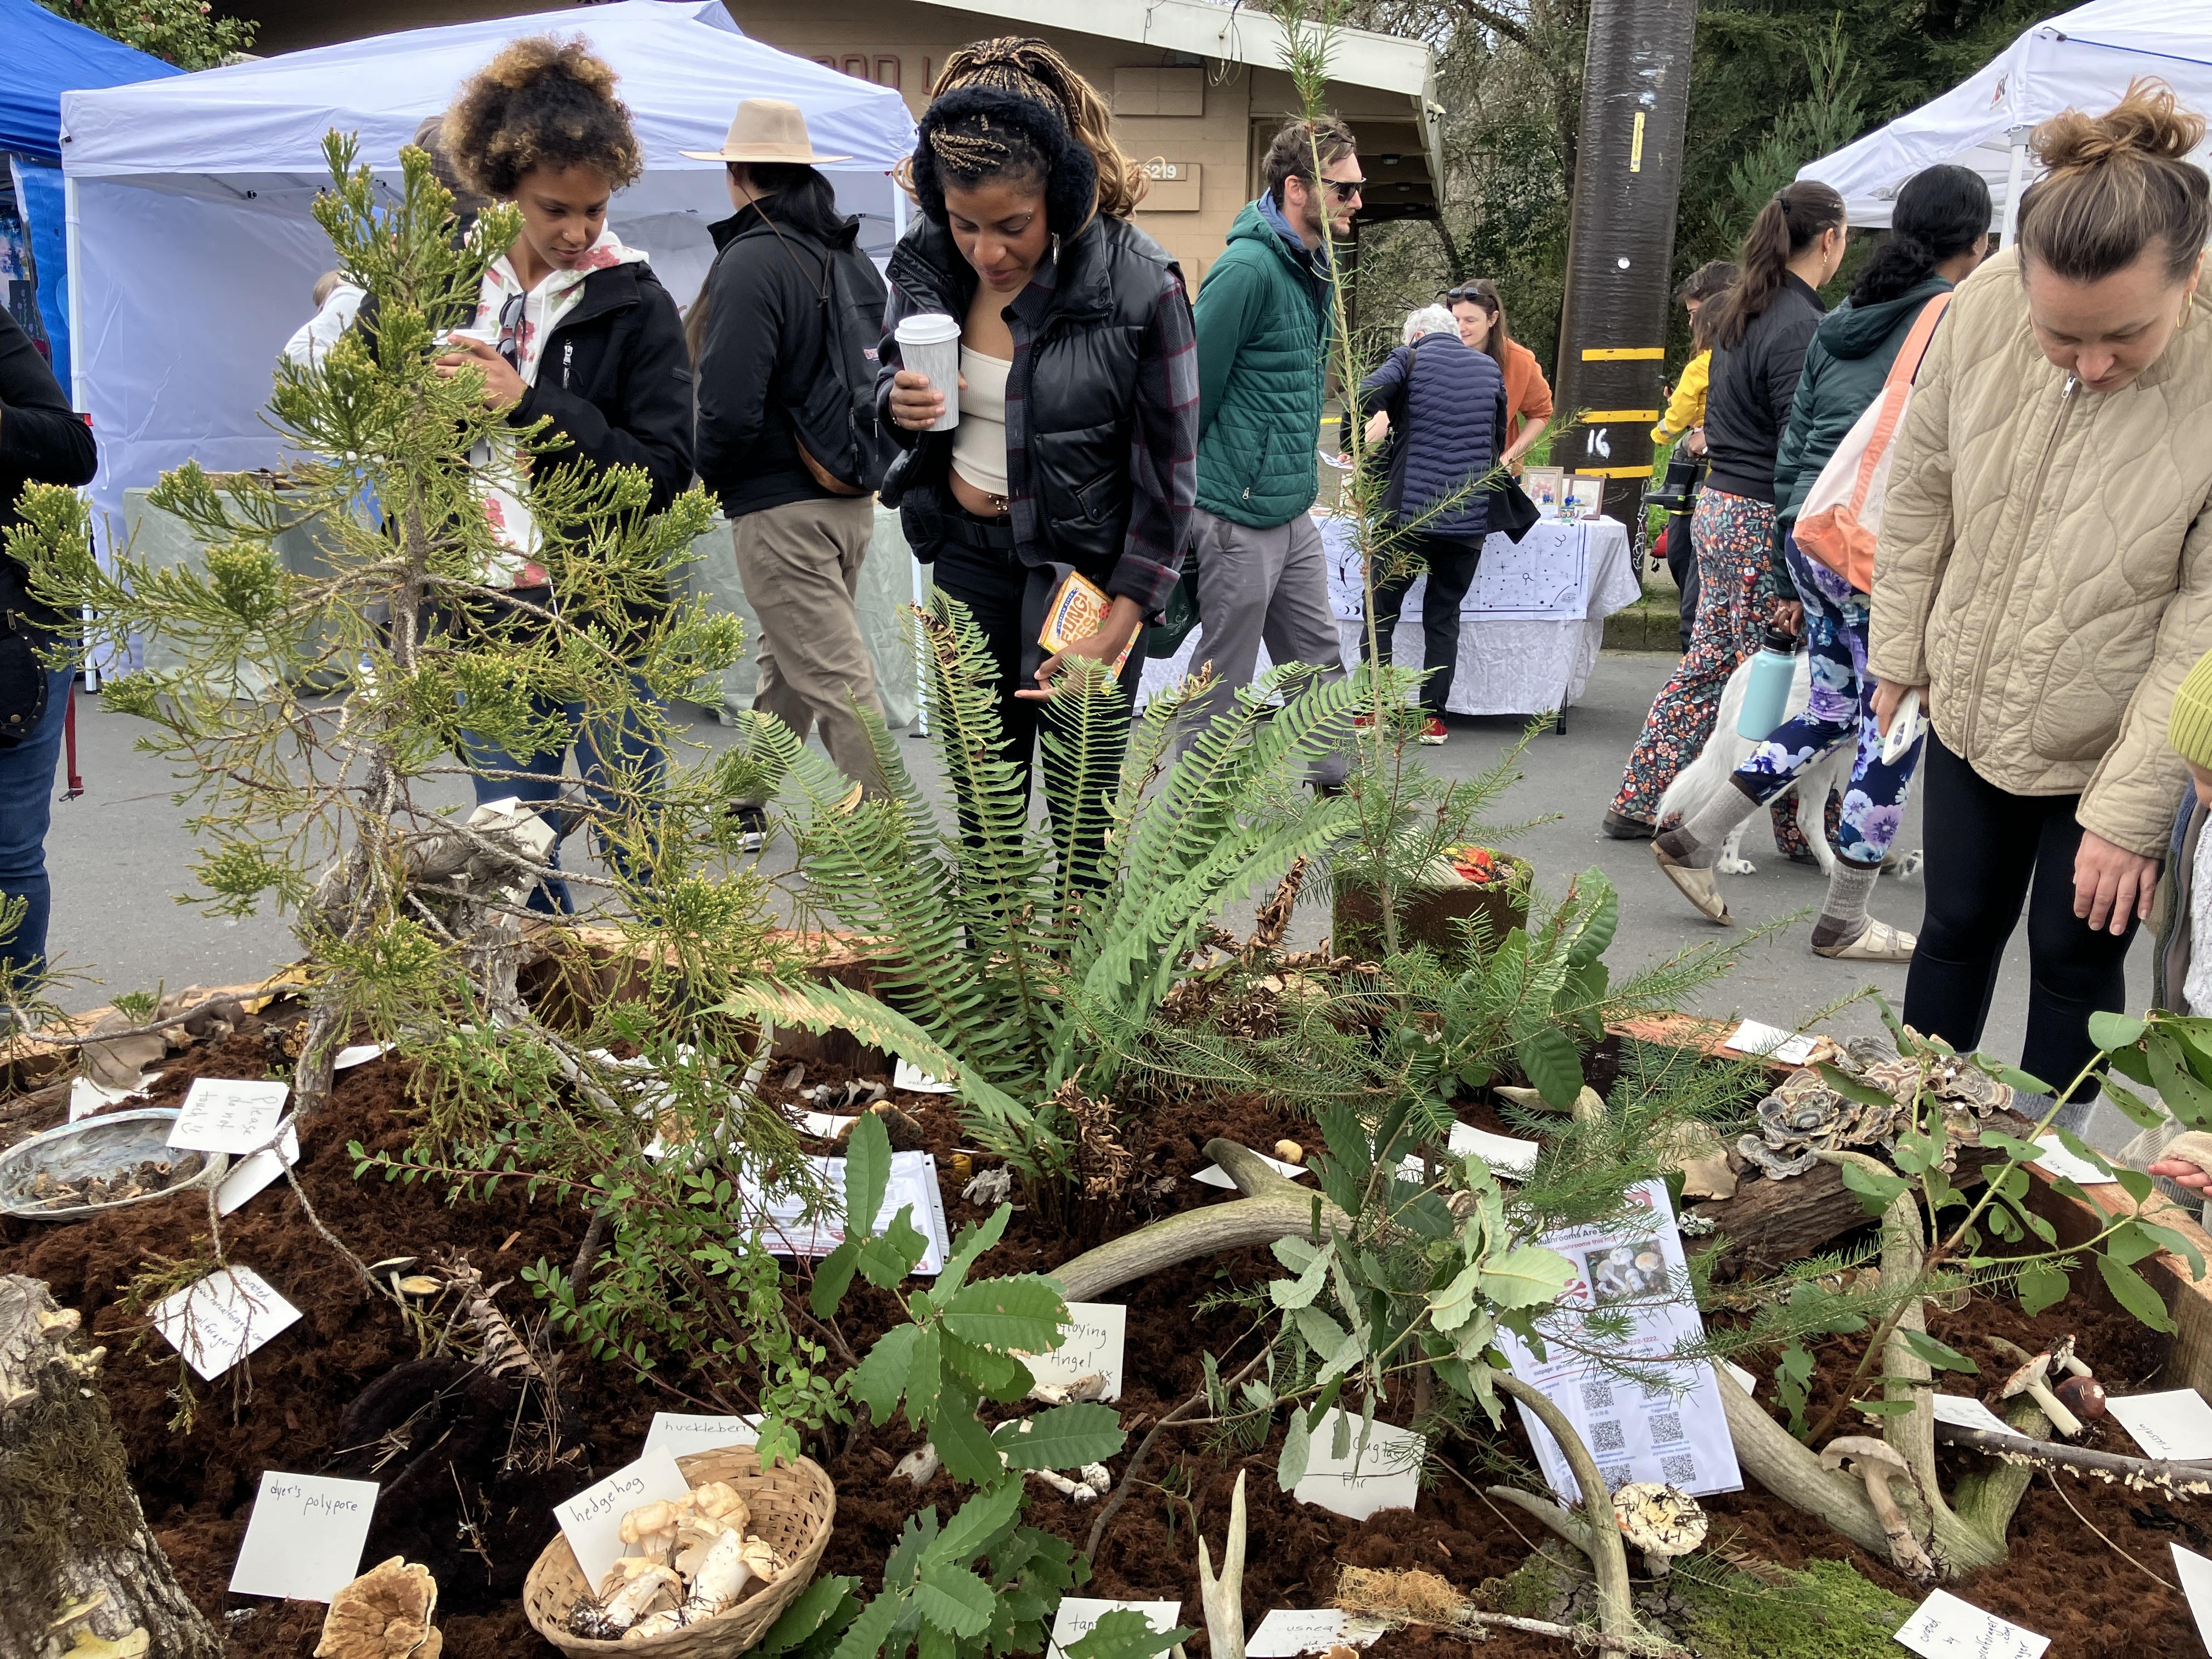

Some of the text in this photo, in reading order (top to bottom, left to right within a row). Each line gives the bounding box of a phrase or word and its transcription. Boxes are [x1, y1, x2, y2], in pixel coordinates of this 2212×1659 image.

[1587, 428, 1611, 459] 16
[1060, 592, 1088, 645] FUNGI
[185, 1091, 219, 1118] touch
[217, 1112, 234, 1130] not
[240, 1276, 272, 1301] curated
[1057, 1323, 1107, 1350] troying
[1051, 1347, 1092, 1373] Angel
[270, 1479, 301, 1501] dyer's
[569, 1477, 645, 1522] hedgehog
[303, 1493, 358, 1516] polypore
[1068, 1613, 1096, 1632] tan
[1920, 1615, 1942, 1643] curated
[1943, 1637, 1962, 1646] by
[1974, 1616, 2005, 1659] orcalforager
